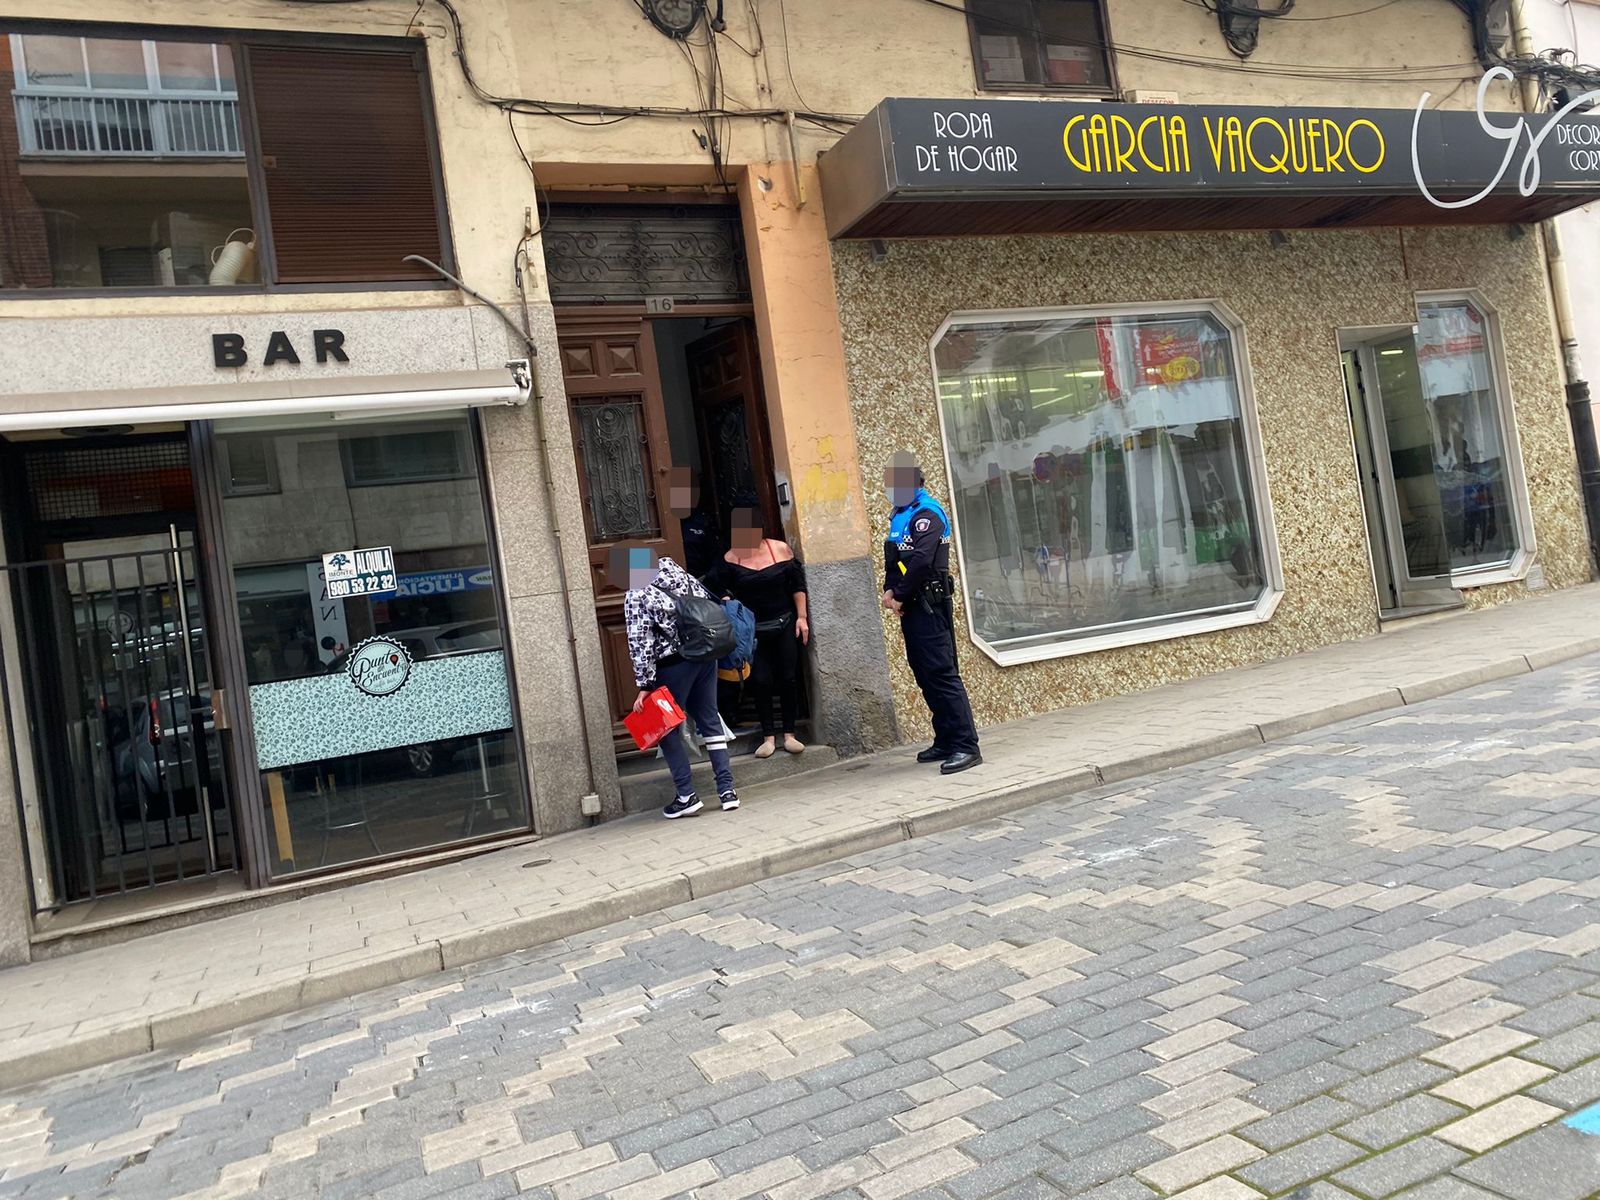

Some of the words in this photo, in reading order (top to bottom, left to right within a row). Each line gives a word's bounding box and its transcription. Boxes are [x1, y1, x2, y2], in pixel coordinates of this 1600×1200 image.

[933, 111, 993, 138] ROPA
[1062, 113, 1191, 173] GARCIA
[1202, 115, 1385, 174] VAQUERO
[915, 145, 941, 171] DE
[948, 145, 1018, 171] HOGAR
[650, 298, 671, 312] 16
[212, 329, 350, 368] BAR
[355, 549, 392, 576] ALQUILA
[329, 580, 350, 596] 980
[351, 578, 365, 593] 53
[366, 576, 380, 592] 22
[380, 574, 395, 590] 32
